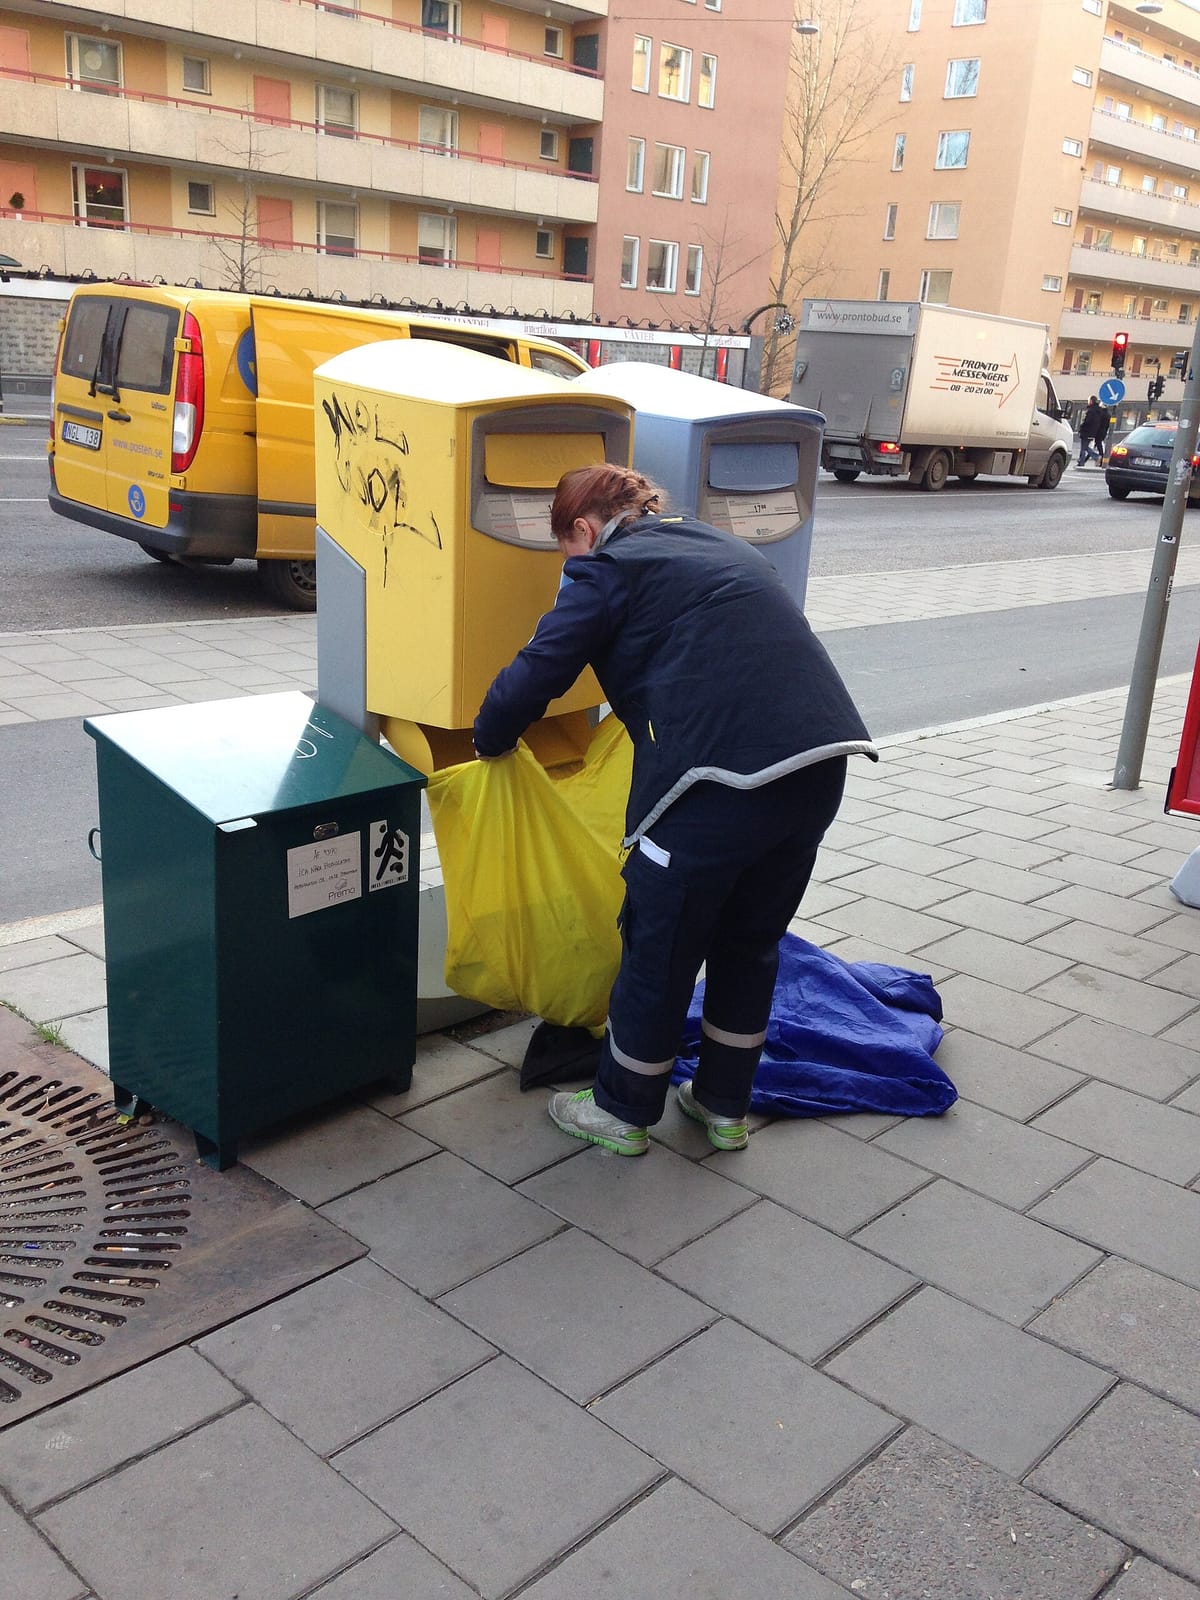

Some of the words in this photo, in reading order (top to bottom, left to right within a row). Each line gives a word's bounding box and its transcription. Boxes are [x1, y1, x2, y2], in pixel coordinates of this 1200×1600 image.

[816, 311, 902, 324] www.prontobud.se
[523, 324, 557, 335] interflora
[960, 359, 999, 372] PRONTO
[952, 368, 1009, 382] MESSENGERS
[950, 384, 961, 392] 08
[964, 385, 975, 393] 20
[66, 423, 80, 440] NGL
[85, 430, 99, 446] 138
[112, 439, 163, 459] www.posten.se
